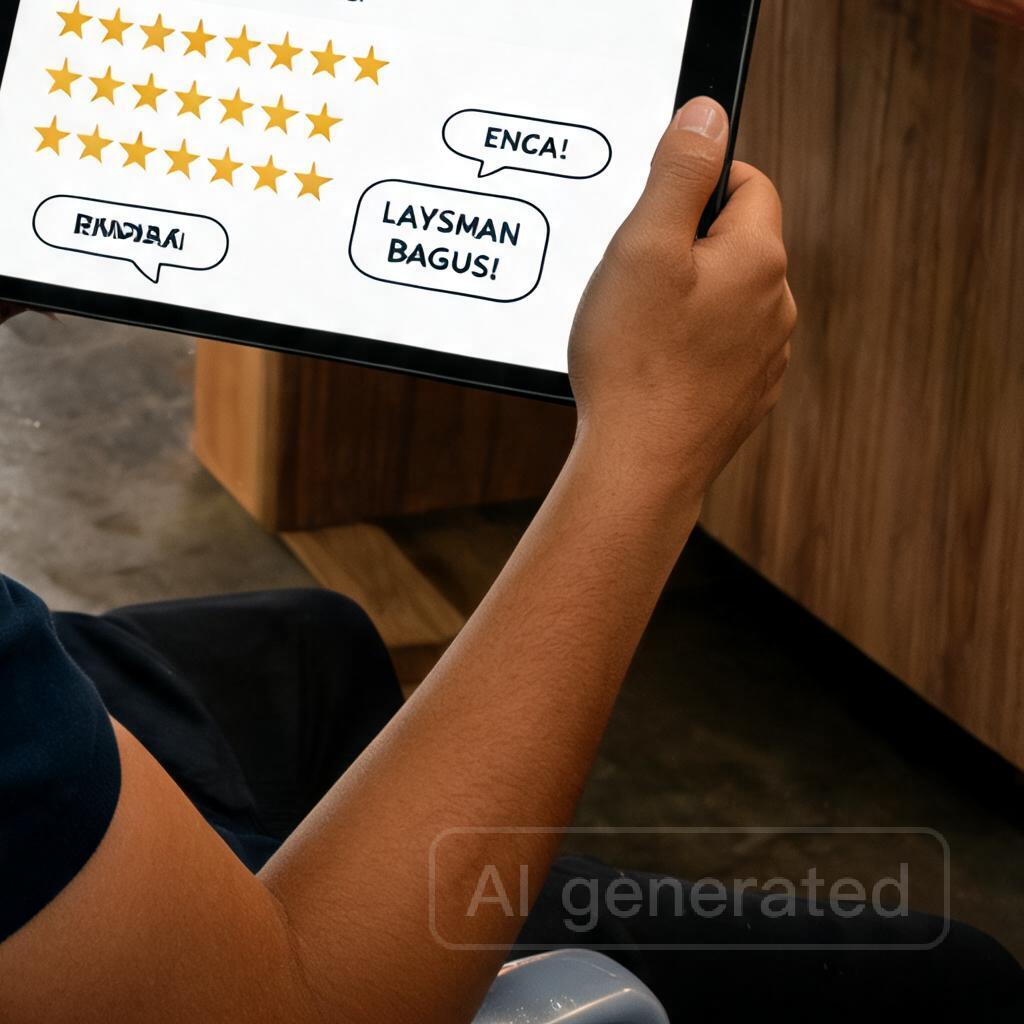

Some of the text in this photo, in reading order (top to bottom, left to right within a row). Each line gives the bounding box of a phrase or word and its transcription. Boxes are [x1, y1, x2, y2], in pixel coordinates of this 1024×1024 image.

[484, 126, 569, 160] ENCA!
[382, 200, 521, 247] LAYSMAN
[387, 238, 500, 281] BAGUS!
